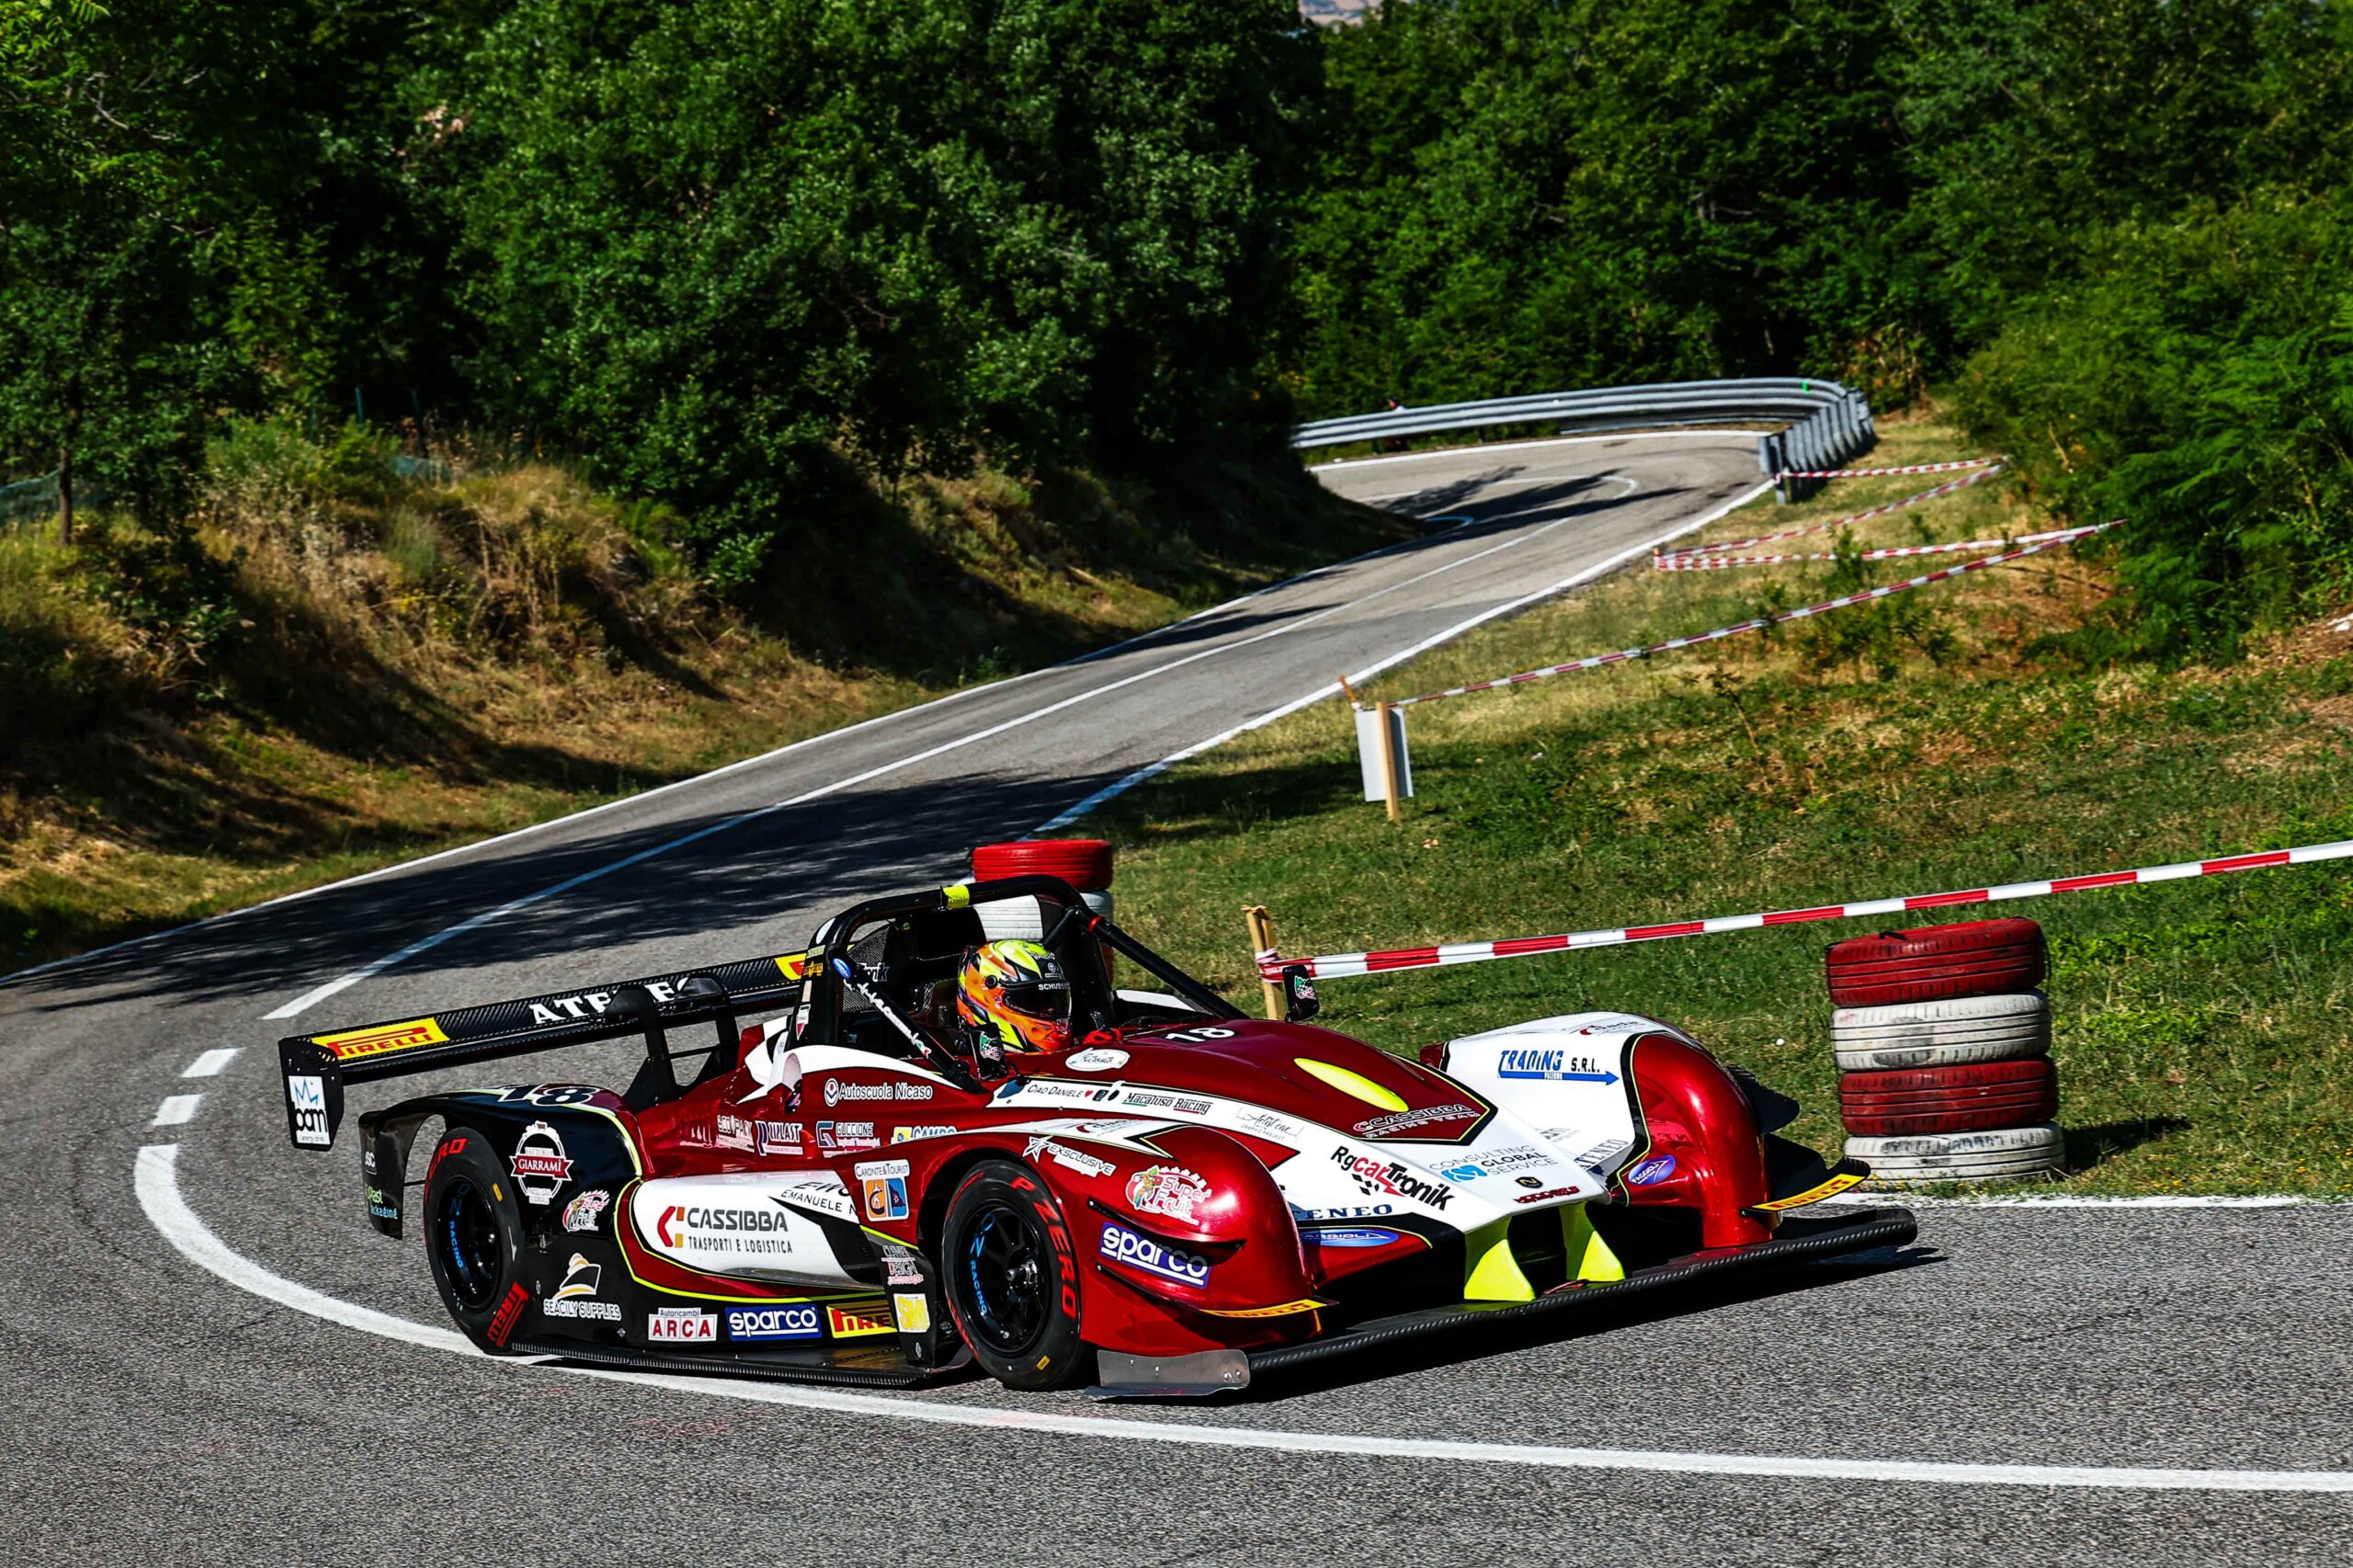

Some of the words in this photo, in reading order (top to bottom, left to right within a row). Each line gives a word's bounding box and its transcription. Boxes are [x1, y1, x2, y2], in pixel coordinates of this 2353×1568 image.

[529, 978, 688, 1024] ATEE
[326, 1027, 433, 1056] PIRELLI
[1165, 1028, 1234, 1042] 18
[1499, 1051, 1563, 1072] TRADING
[1571, 1057, 1600, 1073] S.R.L.
[498, 1083, 601, 1107] 18
[839, 1083, 892, 1099] Autoscuola
[895, 1083, 933, 1099] Nicaso
[1124, 1093, 1174, 1107] Macaluso
[1174, 1097, 1213, 1115] Racing
[1369, 1104, 1472, 1128] CASSIBBA
[836, 1122, 874, 1137] GUCCIONE
[1429, 1144, 1536, 1171] CONSULTING
[1481, 1152, 1549, 1167] GLOBAL
[1486, 1157, 1560, 1176] SERVICE
[781, 1189, 843, 1212] EMANUELE
[1161, 1176, 1211, 1201] Super
[688, 1207, 789, 1233] CASSIBBA
[449, 1220, 464, 1269] RACING
[688, 1236, 733, 1252] TRASPORTI
[736, 1239, 742, 1252] E
[745, 1239, 793, 1254] LOGISTICA
[1011, 1176, 1036, 1191] P
[1032, 1198, 1078, 1320] ZERO
[1103, 1226, 1209, 1278] sparco
[970, 1259, 988, 1316] RACING
[487, 1282, 530, 1347] PIRELLI
[580, 1301, 620, 1320] SUPPLIES
[660, 1307, 700, 1317] Autoricambi
[652, 1319, 711, 1337] ARCA
[729, 1309, 817, 1337] sparco
